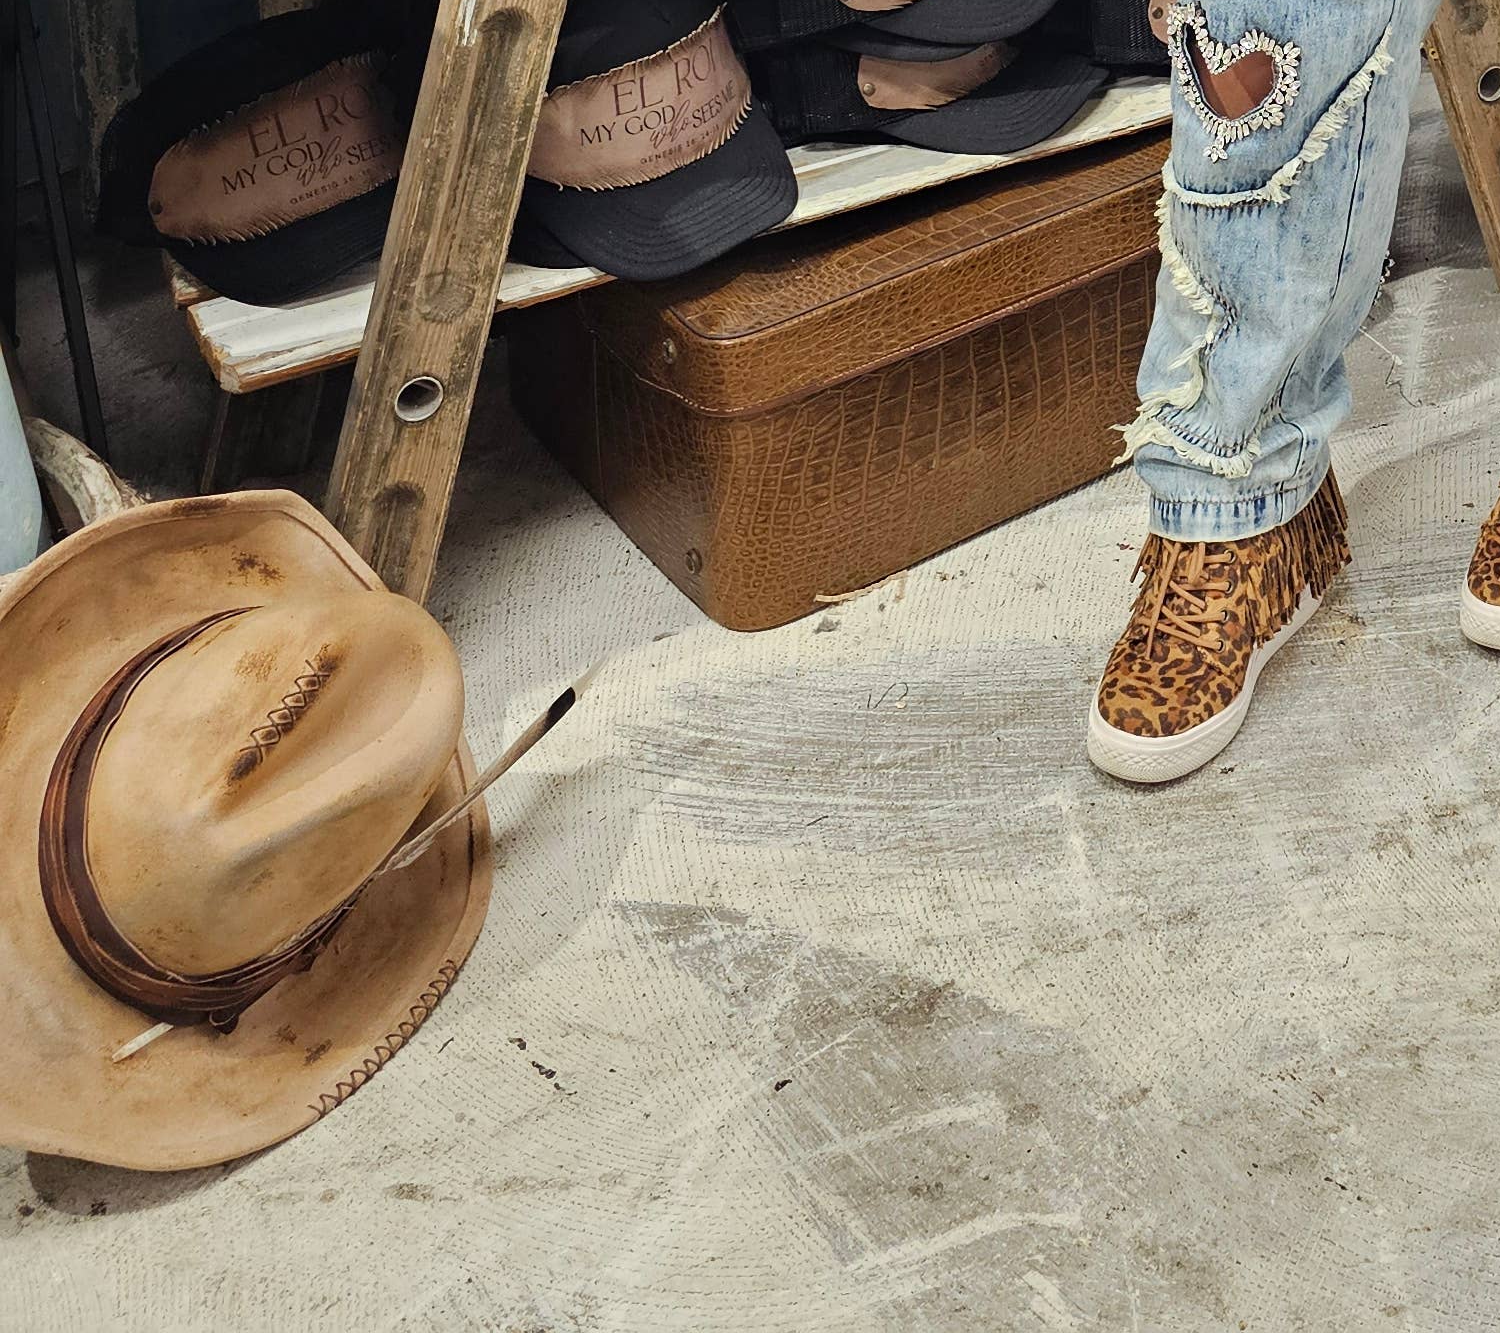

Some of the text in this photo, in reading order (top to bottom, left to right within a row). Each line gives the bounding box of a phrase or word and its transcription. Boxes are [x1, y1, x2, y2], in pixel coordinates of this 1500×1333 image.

[613, 37, 717, 117] EL ROI
[248, 111, 307, 159] EL
[580, 121, 616, 147] MY
[624, 104, 676, 136] GOD
[692, 93, 723, 129] SEES
[220, 164, 257, 196] MY
[266, 140, 324, 176] GOD
